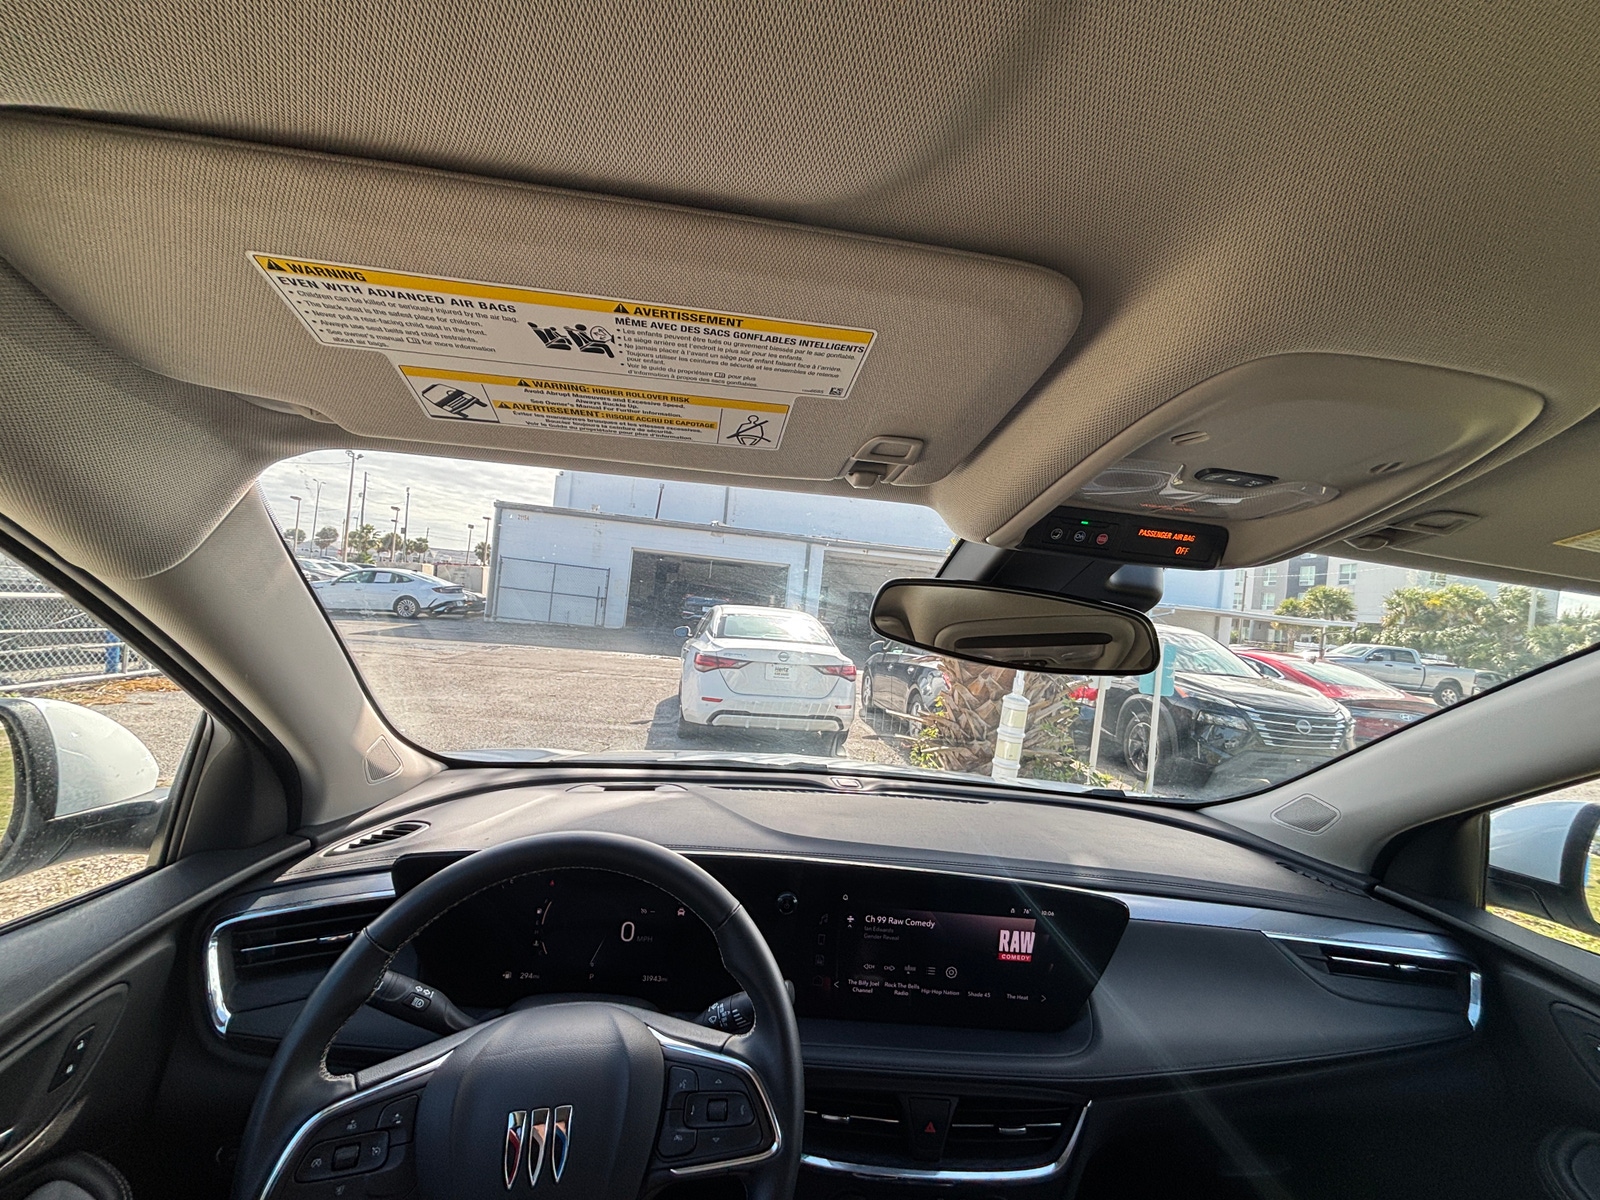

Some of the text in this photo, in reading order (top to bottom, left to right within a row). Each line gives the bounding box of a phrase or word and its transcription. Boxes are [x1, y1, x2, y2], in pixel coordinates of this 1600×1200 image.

[286, 263, 367, 282] WARNING
[277, 276, 517, 313] EVEN WITH ADVANCED AIR BAGS
[297, 290, 334, 300] Children
[364, 298, 387, 307] killed
[398, 303, 435, 314] seriously
[435, 307, 464, 317] injured
[502, 315, 519, 324] bag.
[633, 306, 743, 327] AVERTISSEMENT
[312, 310, 338, 318] Never
[338, 313, 354, 321] put
[360, 316, 405, 327] rear-facing
[414, 314, 436, 322] place
[450, 318, 483, 327] children.
[319, 320, 351, 329] Always
[441, 334, 478, 342] restraints.
[615, 316, 865, 353] MÊME AVEC DES SACS GONFLABLES INTELLIGENTS
[664, 334, 691, 342] peuvent
[734, 342, 768, 351] gravement
[826, 353, 856, 361] gonflable.
[532, 381, 590, 392] WARNING:
[592, 388, 623, 396] HIGHER
[626, 391, 668, 401] ROLLOVER
[511, 403, 601, 417] AVERTISSEMENT
[1138, 529, 1172, 539] PASSENGER
[1176, 546, 1189, 555] OFF
[621, 921, 635, 942] 0
[888, 917, 903, 925] Raw
[905, 918, 935, 929] Comedy
[999, 930, 1036, 953] RAW
